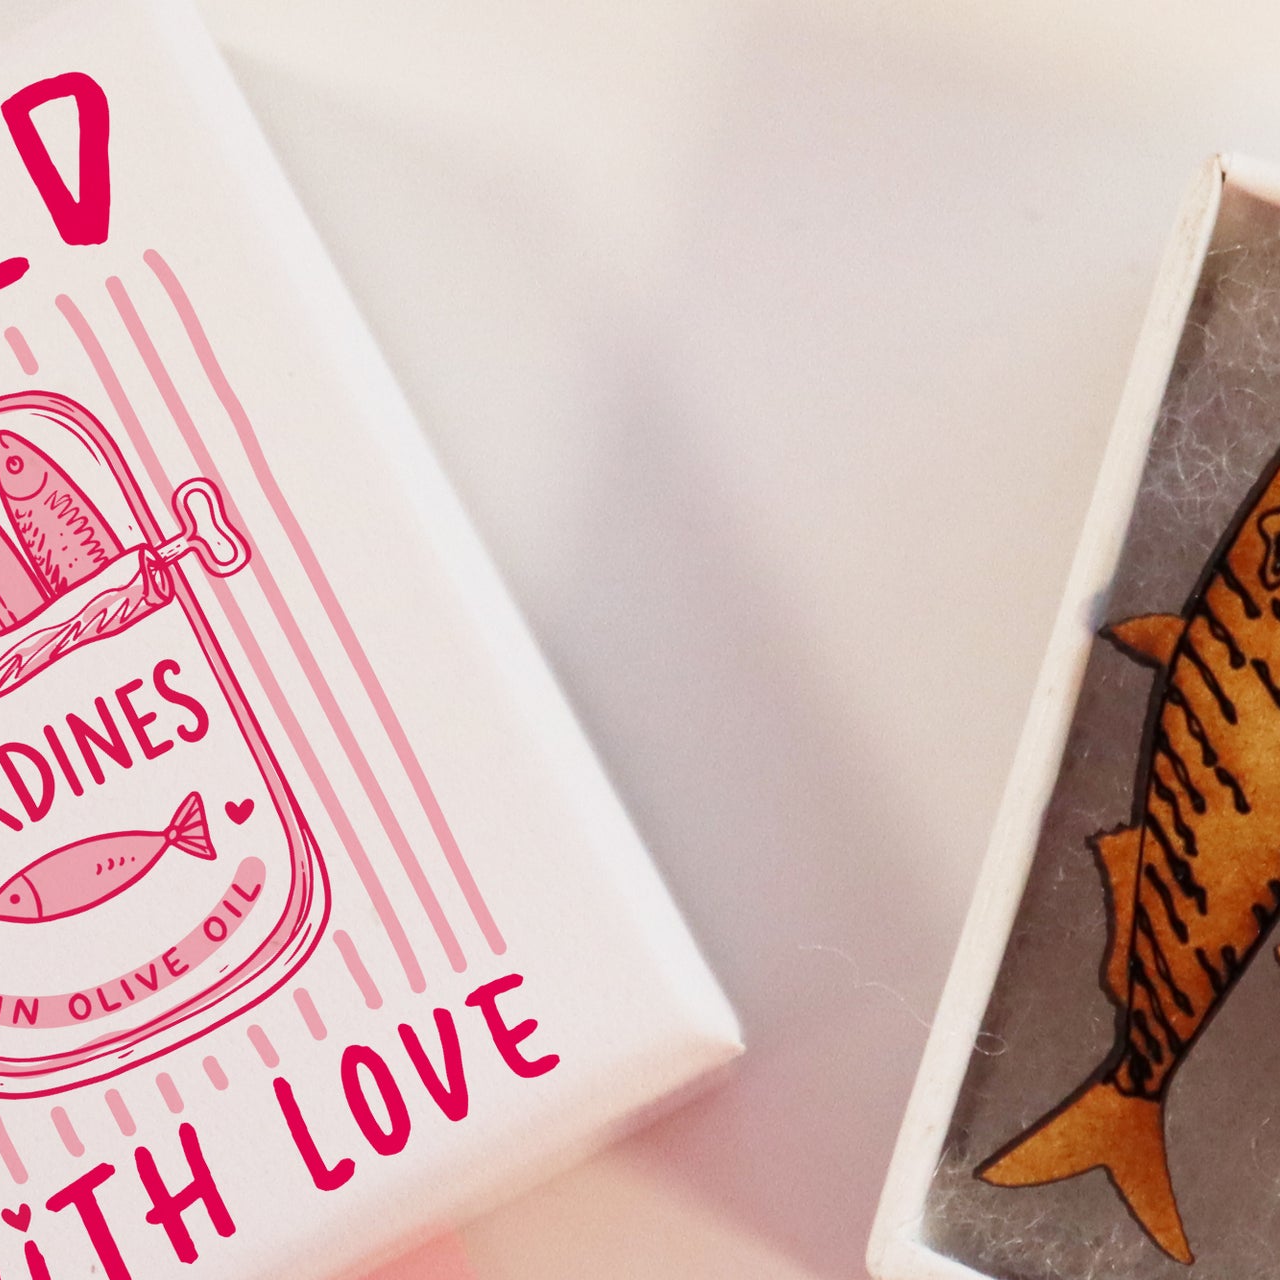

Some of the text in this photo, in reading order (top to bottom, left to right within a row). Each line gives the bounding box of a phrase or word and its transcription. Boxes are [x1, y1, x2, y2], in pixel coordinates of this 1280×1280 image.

[68, 946, 190, 1021] OLIVE
[202, 883, 261, 942] OIL
[272, 973, 561, 1192] LOVE
